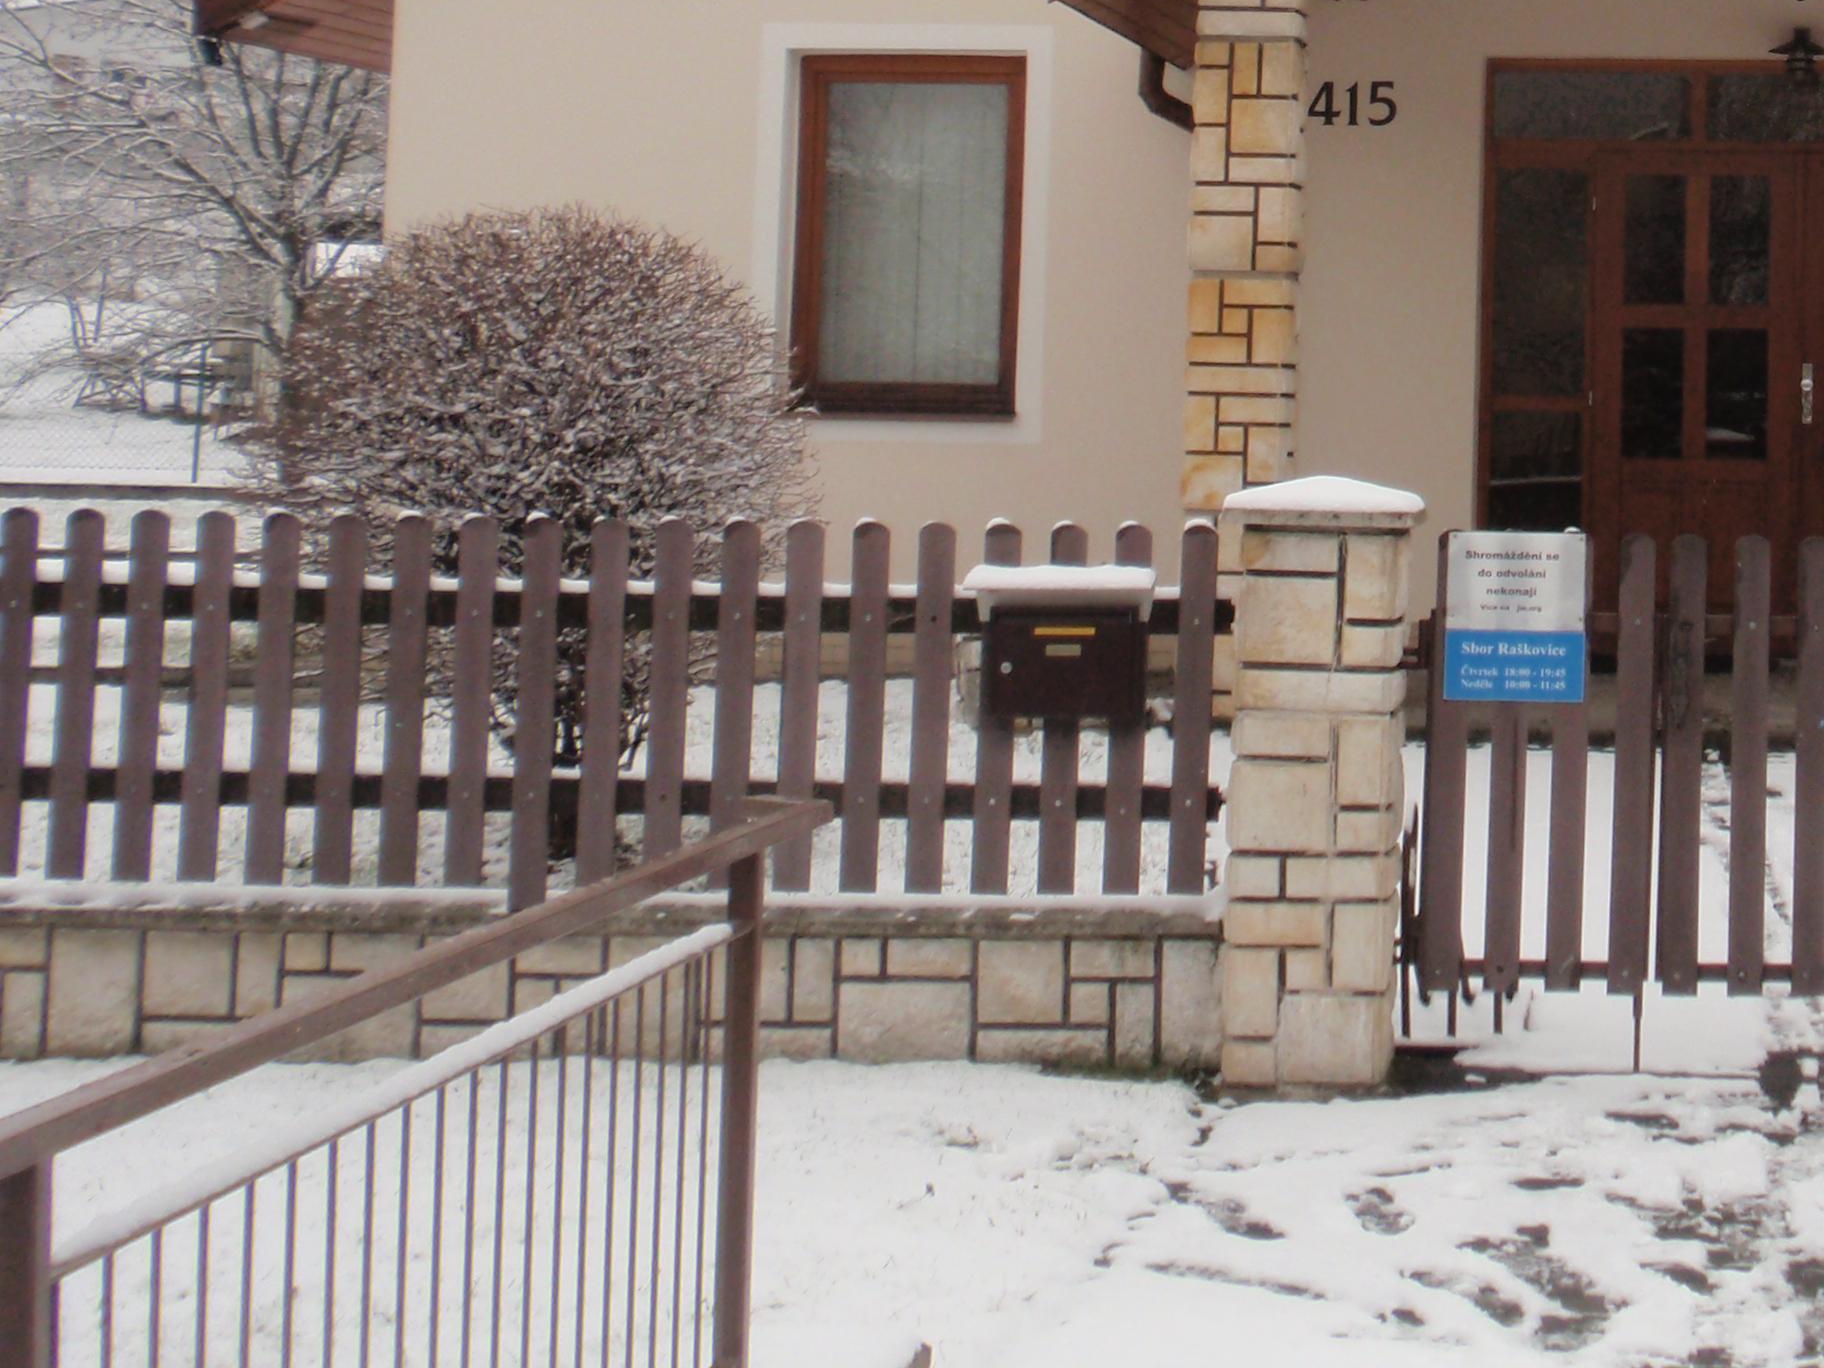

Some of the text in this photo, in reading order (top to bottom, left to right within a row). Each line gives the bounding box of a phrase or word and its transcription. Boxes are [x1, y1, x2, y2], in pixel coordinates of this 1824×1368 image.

[1307, 81, 1397, 126] 415
[1465, 550, 1560, 561] Shromáždění se
[1478, 569, 1546, 579] do odvolání
[1486, 587, 1537, 598] nekonají
[1461, 641, 1566, 656] Sbor Raškovice
[1461, 664, 1498, 676] Čtvrtek
[1504, 667, 1531, 677] 18:00
[1540, 668, 1566, 678] 19:45
[1461, 678, 1492, 689] Neděle
[1504, 679, 1531, 689] 10:00
[1540, 680, 1566, 689] 11:45
